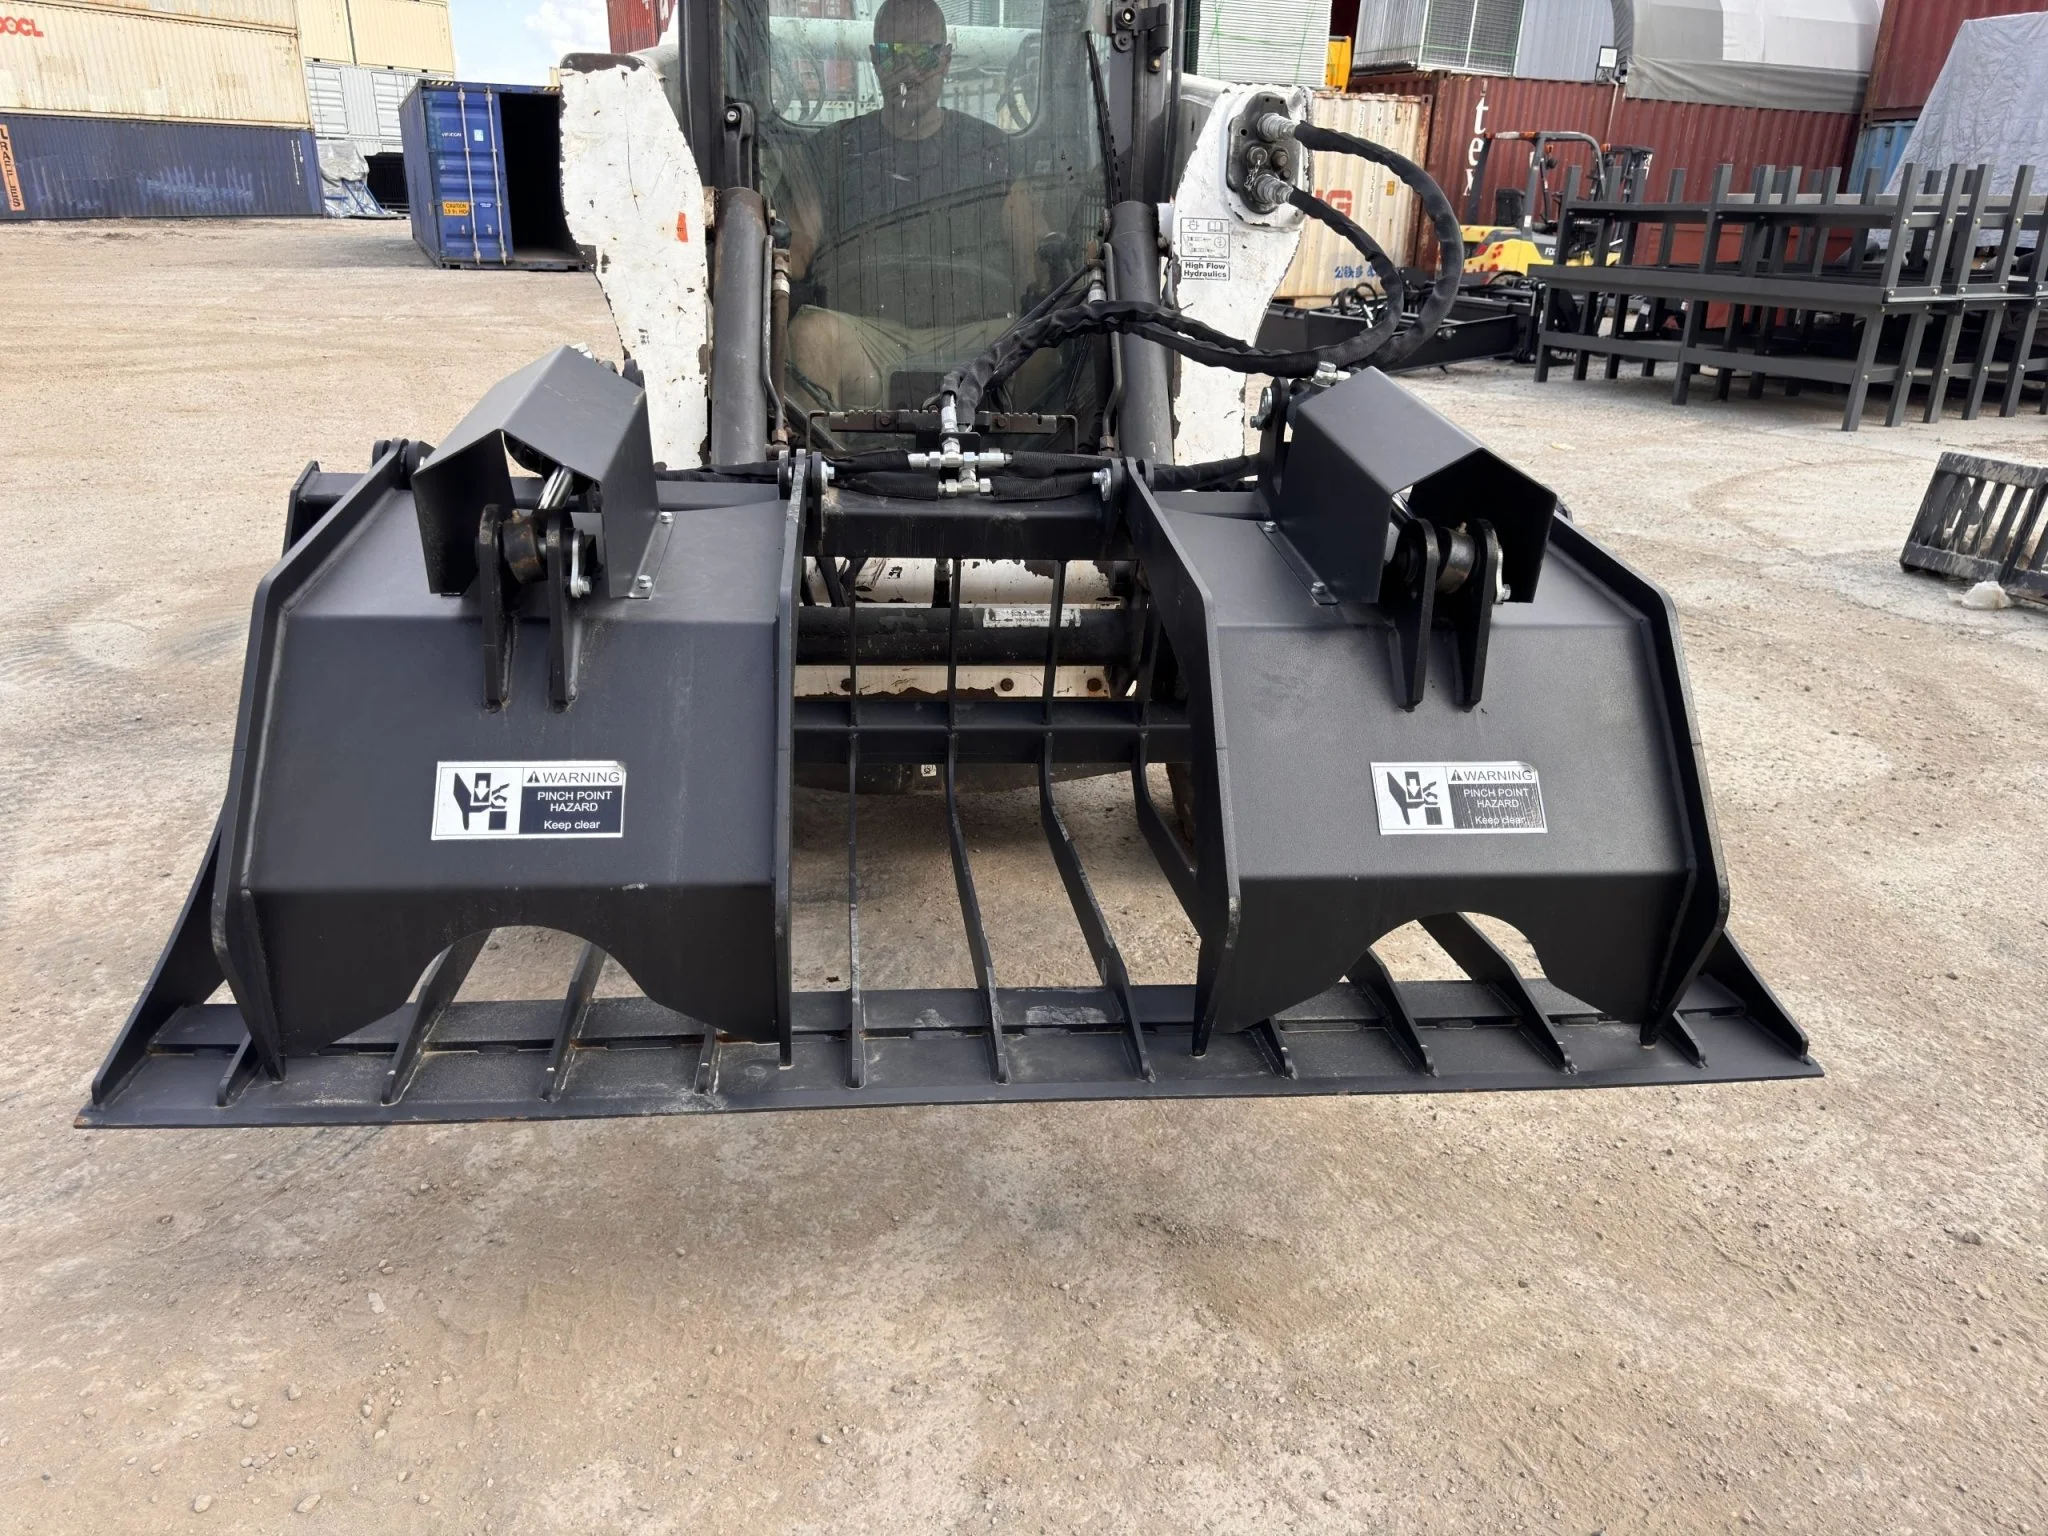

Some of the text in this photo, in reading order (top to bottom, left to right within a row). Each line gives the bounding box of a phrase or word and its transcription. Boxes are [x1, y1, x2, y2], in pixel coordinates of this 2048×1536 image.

[1185, 262, 1203, 270] High
[543, 771, 620, 783] WARNING
[1463, 770, 1533, 781] WARNING
[537, 790, 612, 801] PINCH POINT
[1463, 788, 1528, 798] PINCH POINT
[550, 802, 598, 812] HAZARD
[1476, 799, 1519, 808] HAZARD
[544, 820, 601, 831] Keep clear
[1475, 815, 1526, 826] Keep clear
